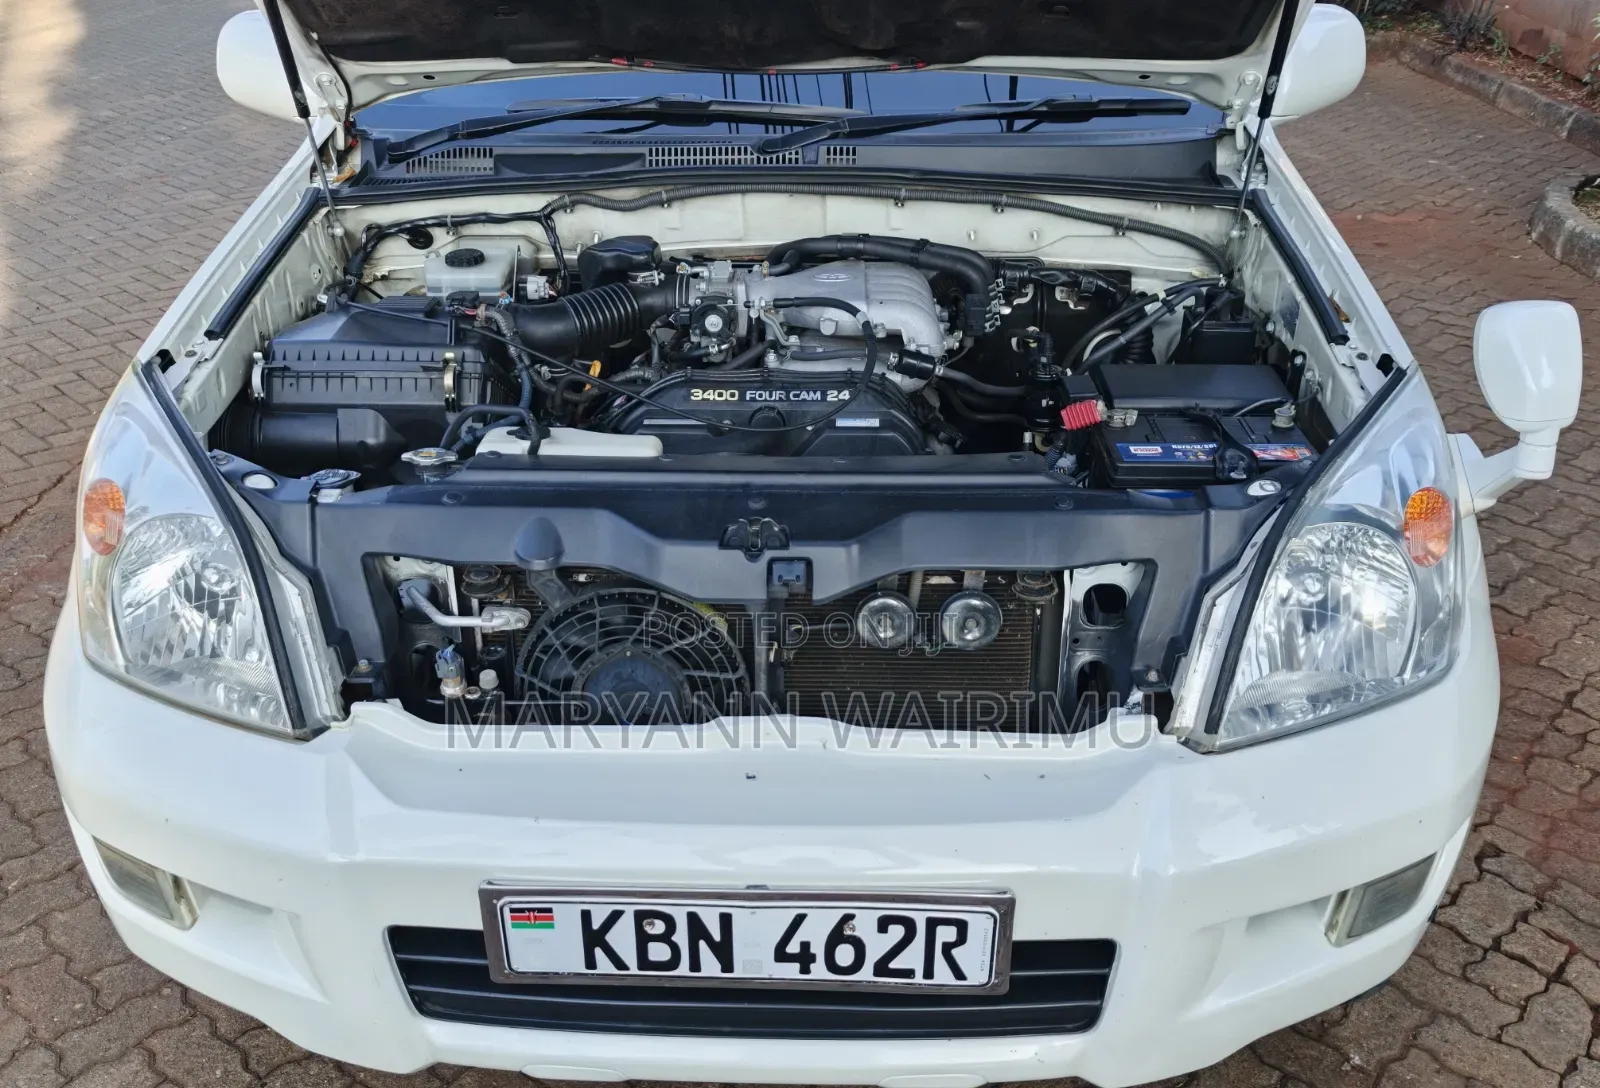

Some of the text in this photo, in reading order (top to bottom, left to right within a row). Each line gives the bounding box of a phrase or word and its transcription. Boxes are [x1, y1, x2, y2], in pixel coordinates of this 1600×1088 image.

[690, 388, 851, 401] 3400 FOUR CAM 24
[580, 908, 735, 974] KBN
[773, 913, 969, 981] 462R
